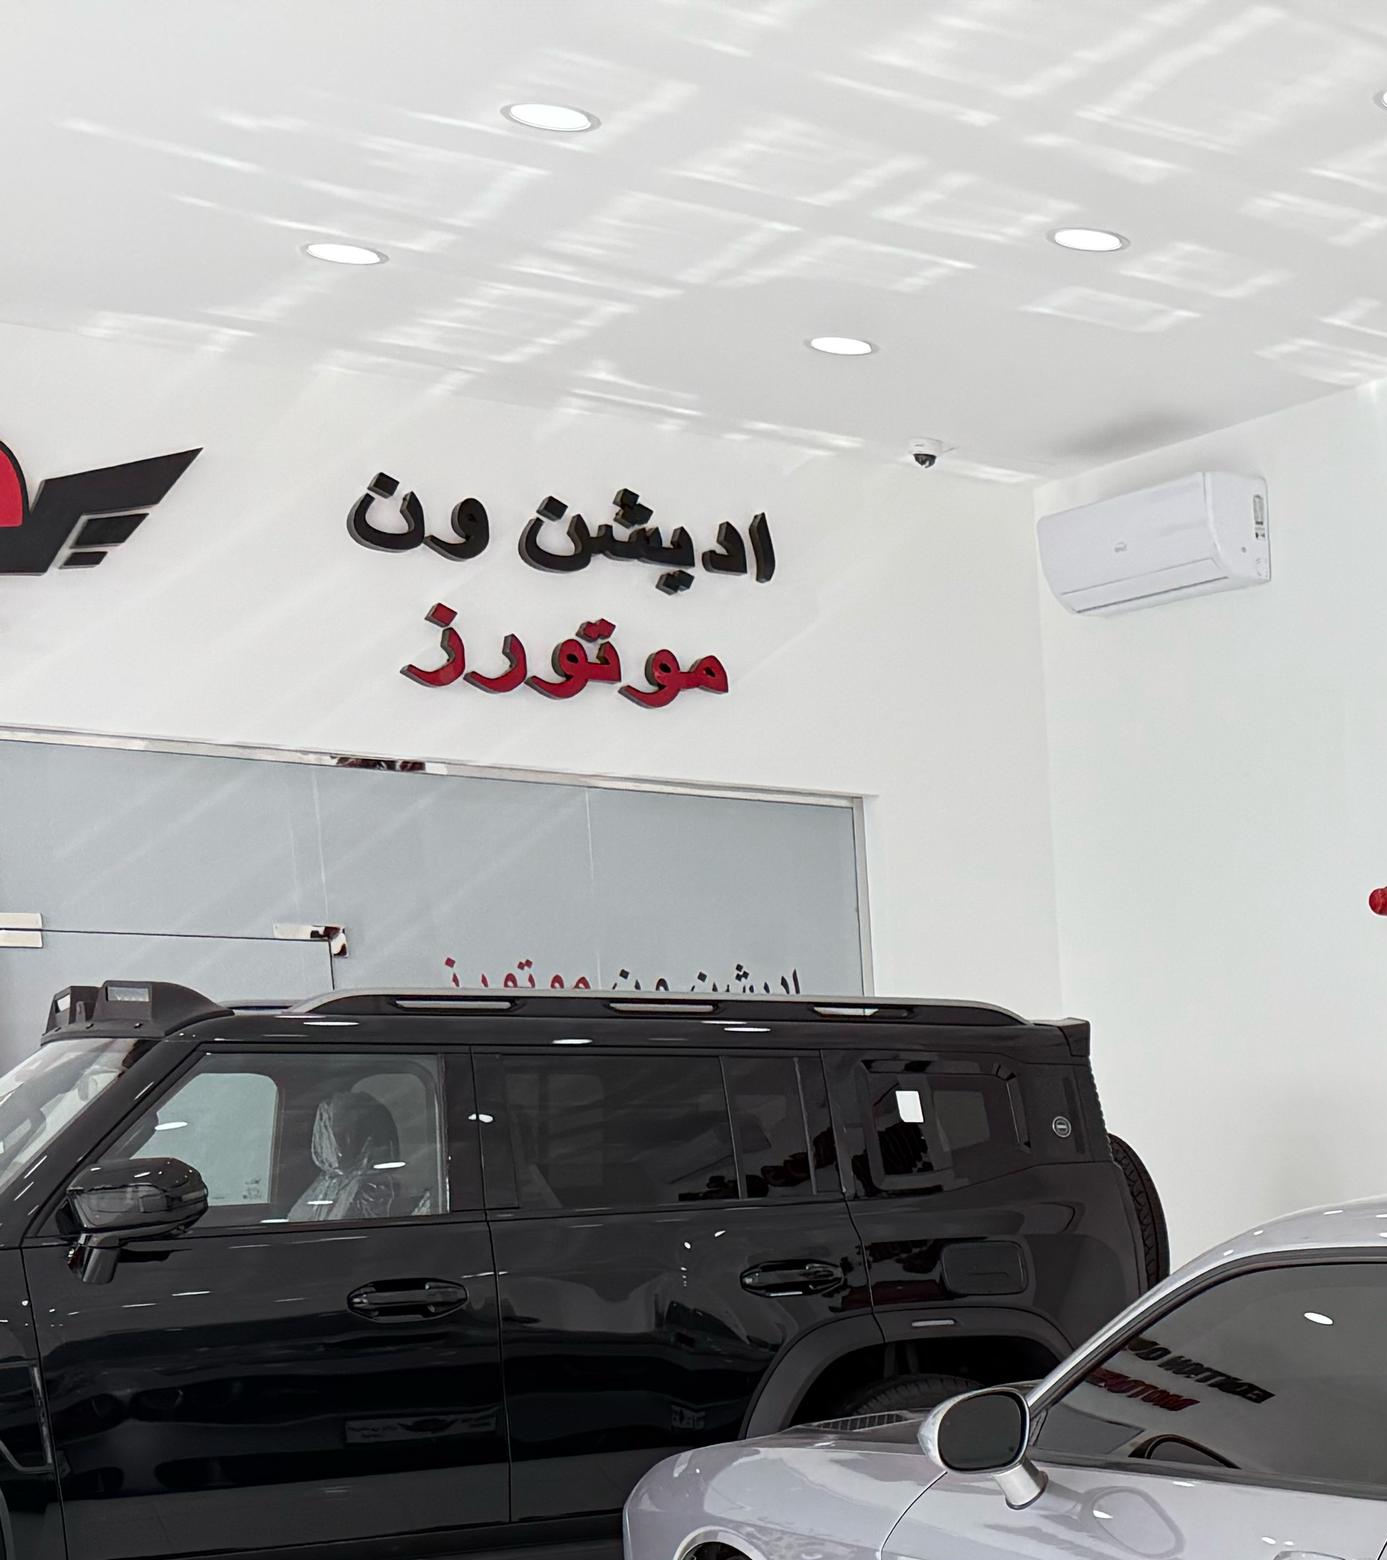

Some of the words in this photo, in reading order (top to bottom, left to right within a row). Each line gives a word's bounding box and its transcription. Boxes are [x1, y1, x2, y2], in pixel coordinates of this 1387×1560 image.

[347, 471, 490, 561] ون
[518, 488, 776, 595] اديشن
[400, 602, 729, 709] موتورز
